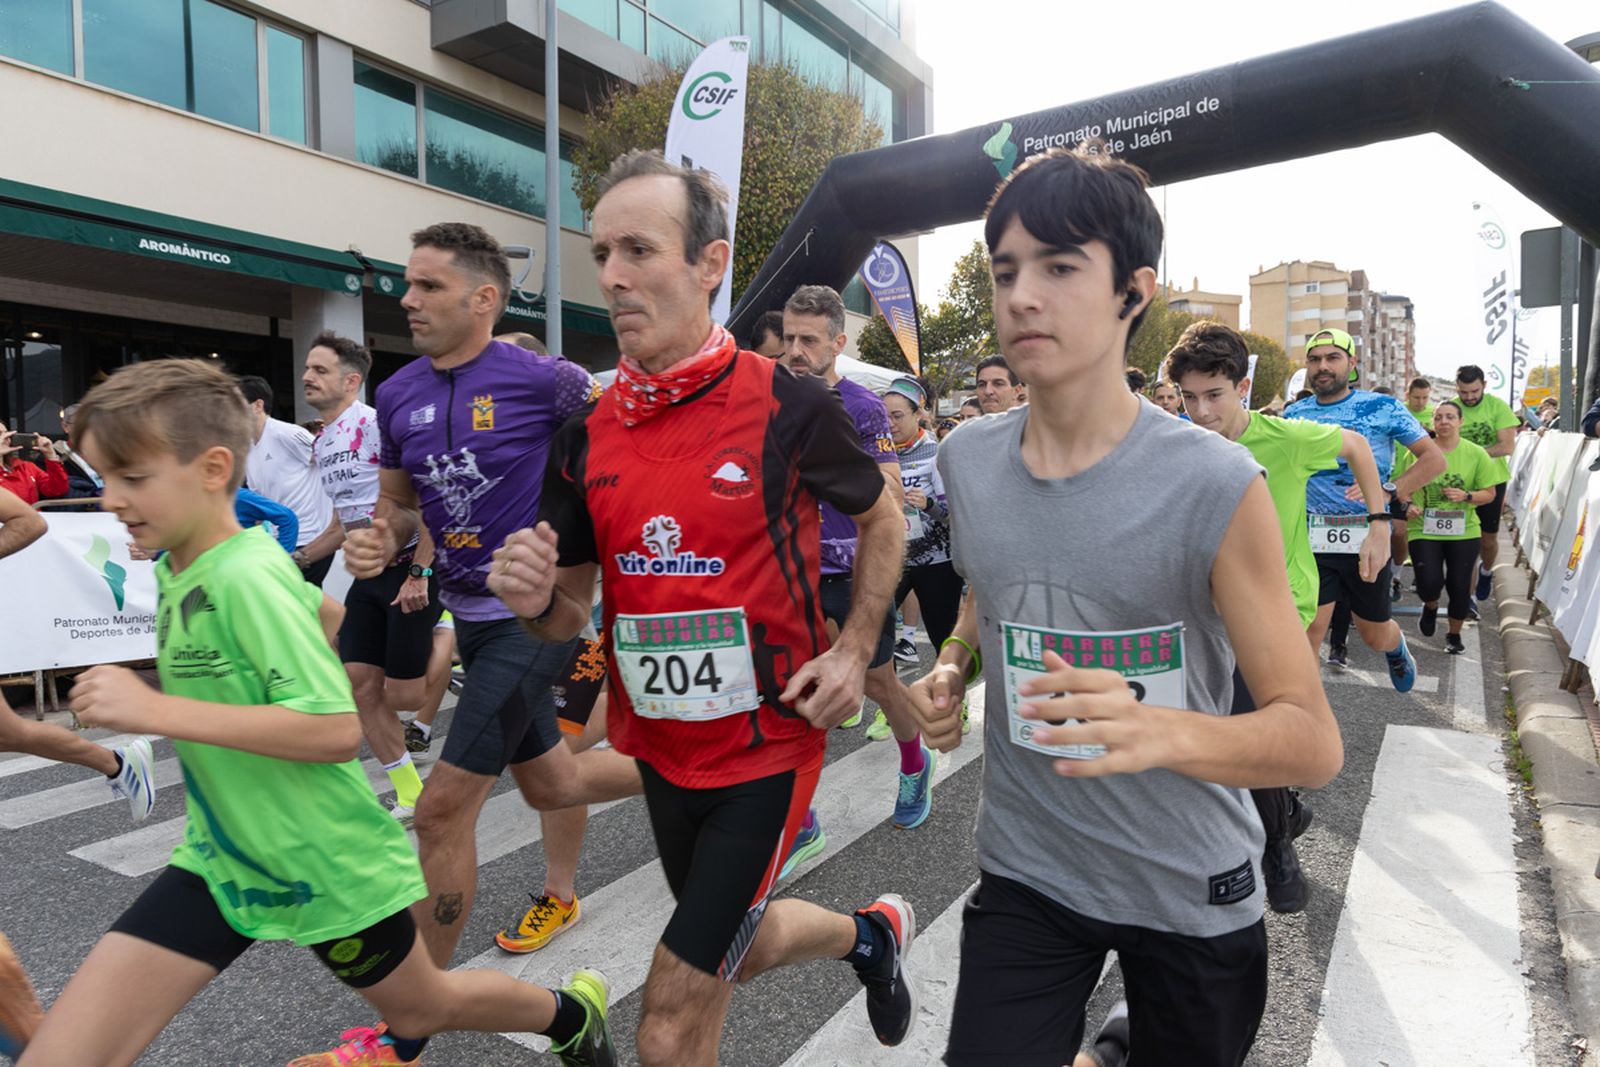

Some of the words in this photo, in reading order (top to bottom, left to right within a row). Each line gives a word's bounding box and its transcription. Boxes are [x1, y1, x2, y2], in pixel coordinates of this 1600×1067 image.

[693, 86, 738, 104] CSIF
[1023, 126, 1101, 153] Patronato
[1106, 102, 1191, 133] Municipal
[1196, 97, 1220, 114] de
[1103, 137, 1125, 155] de
[1129, 128, 1173, 150] Jaén
[1436, 520, 1453, 530] 68
[1327, 529, 1350, 543] 66
[617, 554, 648, 574] kit
[650, 553, 723, 574] online
[54, 617, 109, 628] Patronato
[113, 614, 158, 626] Municip
[637, 614, 734, 631] CARRERA
[70, 626, 123, 640] Deportes
[126, 627, 141, 635] de
[144, 624, 157, 634] Ja
[639, 626, 735, 643] POPULAR
[1011, 629, 1041, 661] XI
[1043, 632, 1172, 651] CARRERA
[1061, 648, 1172, 667] OPULAR
[639, 652, 722, 696] 204
